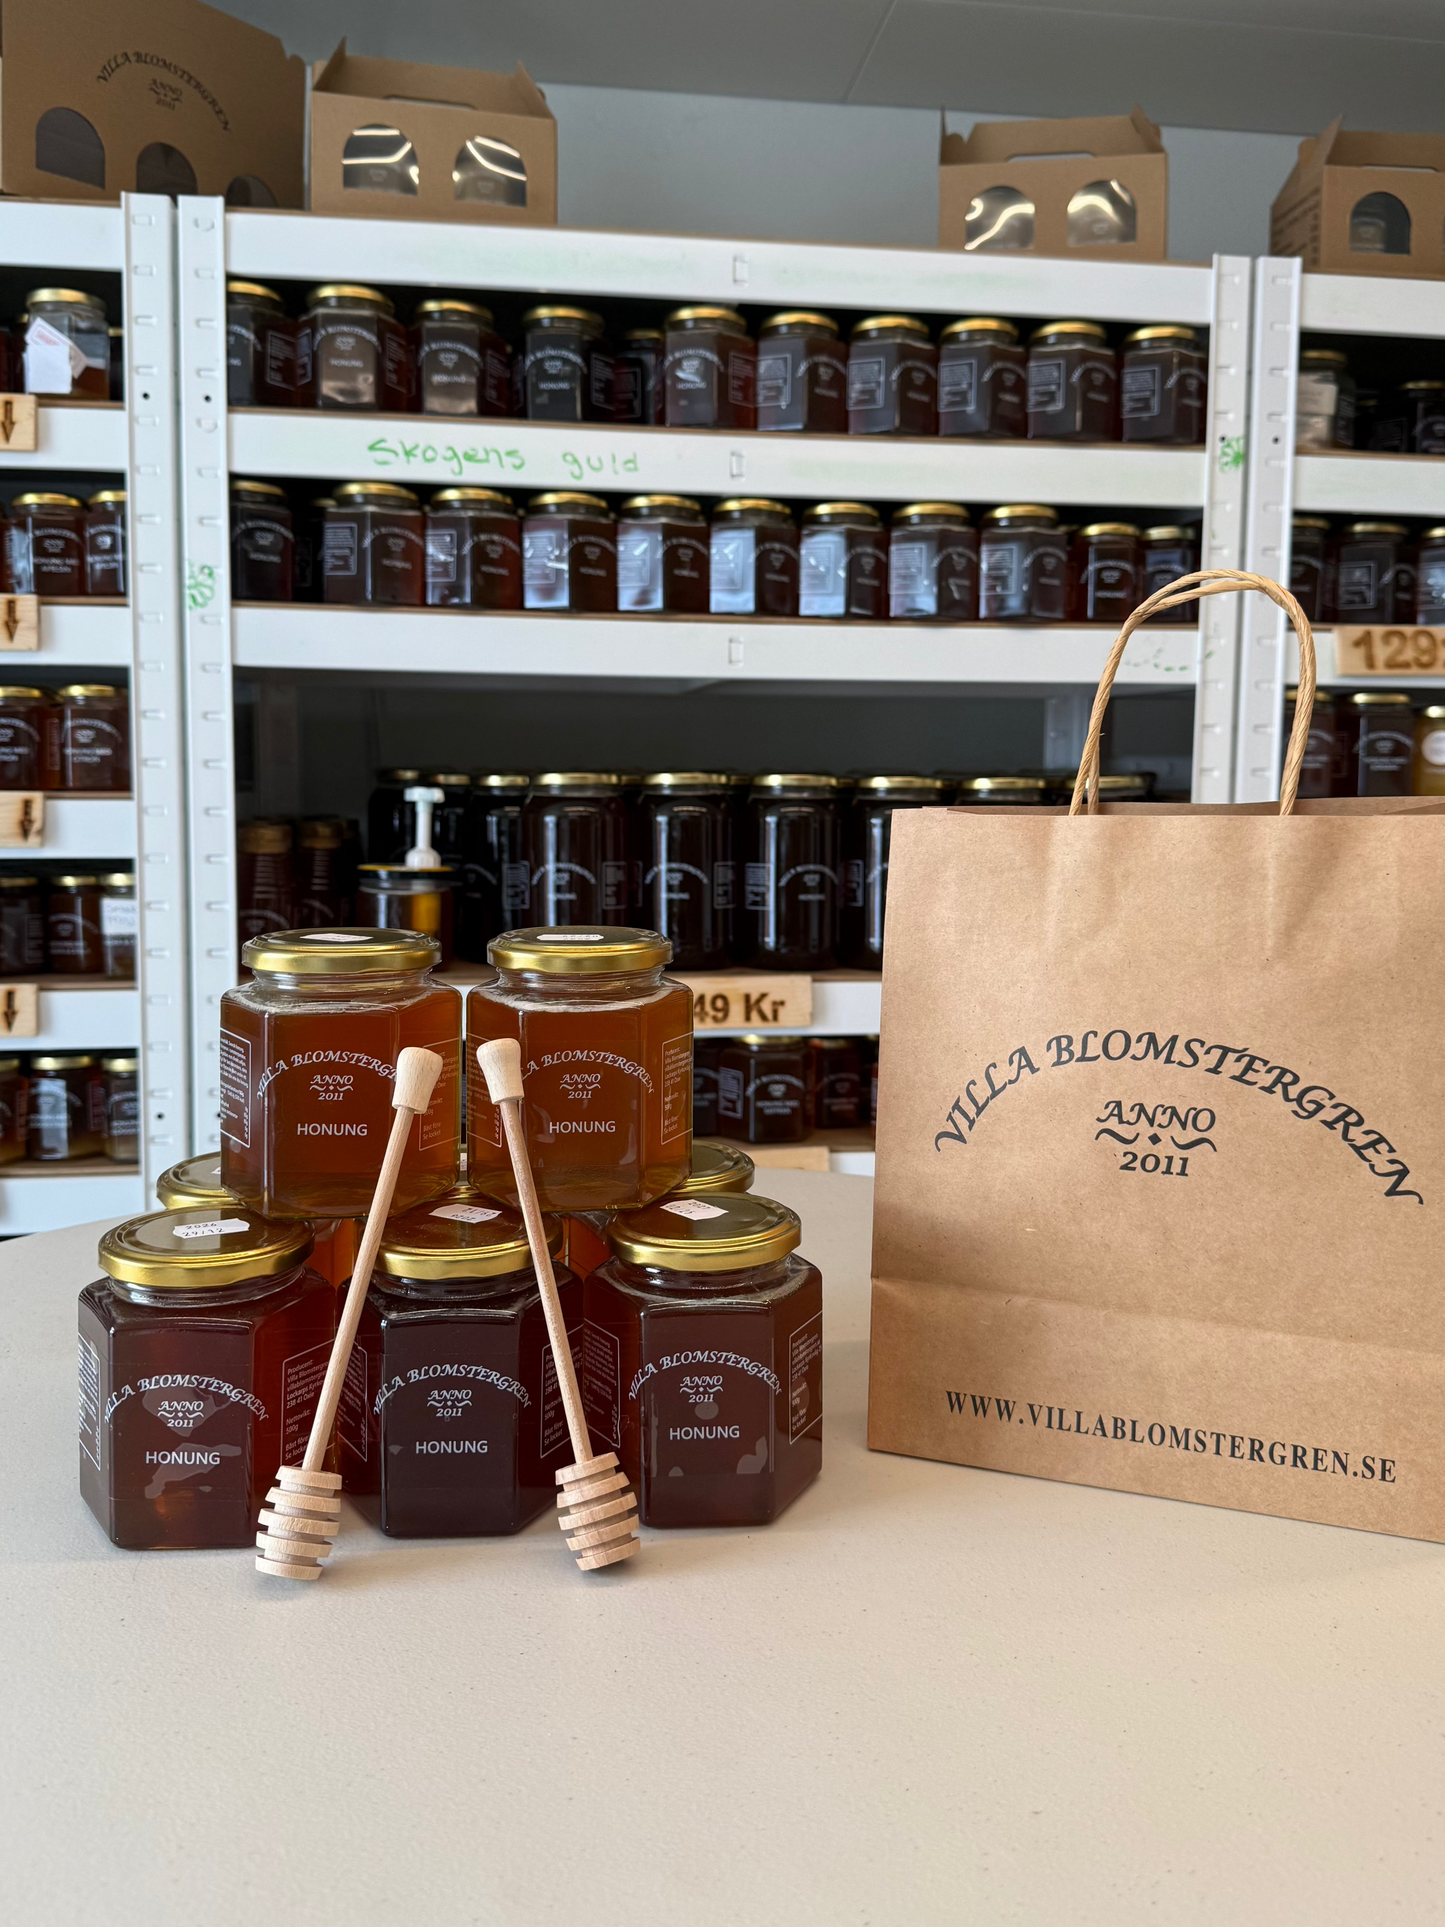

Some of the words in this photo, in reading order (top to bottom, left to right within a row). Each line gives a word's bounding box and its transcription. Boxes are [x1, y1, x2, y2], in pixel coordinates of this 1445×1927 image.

[368, 439, 525, 476] Skogens
[562, 452, 639, 480] guld
[743, 992, 785, 1023] Kr
[541, 1050, 654, 1093] BLOMSTERGREN
[560, 1073, 601, 1083] ANNO
[310, 1075, 354, 1085] ANNO
[318, 1092, 344, 1100] 2011
[568, 1091, 592, 1099] 2011
[935, 1046, 1040, 1153] VILLA
[1046, 1029, 1423, 1205] BLOMSTERGREN
[1096, 1100, 1216, 1133] ANNO
[297, 1123, 368, 1136] HONUNG
[549, 1121, 616, 1133] HONUNG
[1120, 1151, 1189, 1177] 2011
[628, 1362, 659, 1401] VILLA
[659, 1350, 783, 1395] BLOMSTERGREN
[680, 1375, 723, 1386] ANNO
[407, 1364, 532, 1408] BLOMSTERGREN
[137, 1374, 269, 1421] BLOMSTERGREN
[427, 1389, 472, 1400] ANNO
[688, 1394, 714, 1403] 2011
[158, 1400, 204, 1411] ANNO
[436, 1408, 463, 1417] 2011
[167, 1419, 194, 1428] 2011
[670, 1425, 740, 1441] HONUNG
[945, 1390, 1397, 1484] WWW.VILLABLOMSTERGREN.SE
[415, 1440, 489, 1455] HONUNG
[145, 1451, 221, 1465] HONUNG
